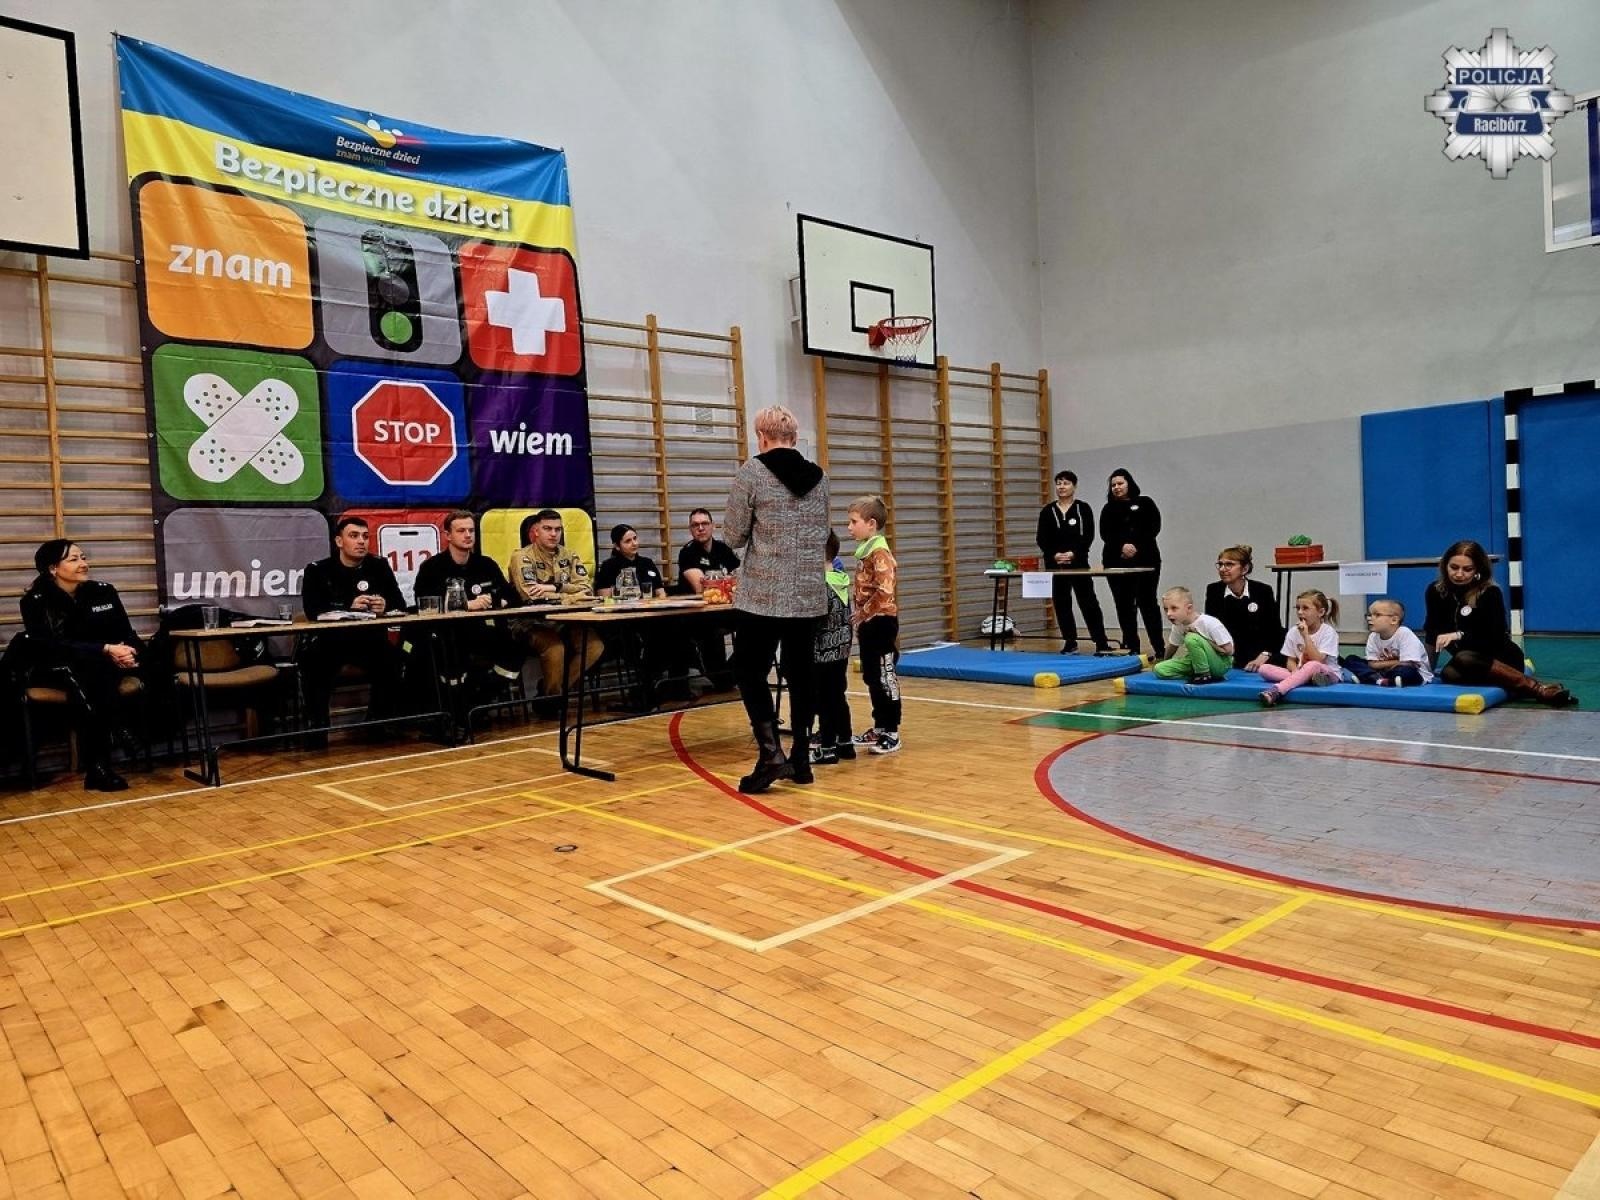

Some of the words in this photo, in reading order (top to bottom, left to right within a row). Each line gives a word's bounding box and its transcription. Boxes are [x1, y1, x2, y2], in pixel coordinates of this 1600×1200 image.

[336, 136, 391, 158] Bezpieczne
[393, 151, 421, 165] dzieci
[336, 149, 361, 161] znam
[215, 140, 414, 213] Bezpieczne
[424, 191, 510, 230] dzieci
[168, 243, 293, 289] znam
[373, 420, 441, 444] STOP
[489, 422, 573, 456] wiem
